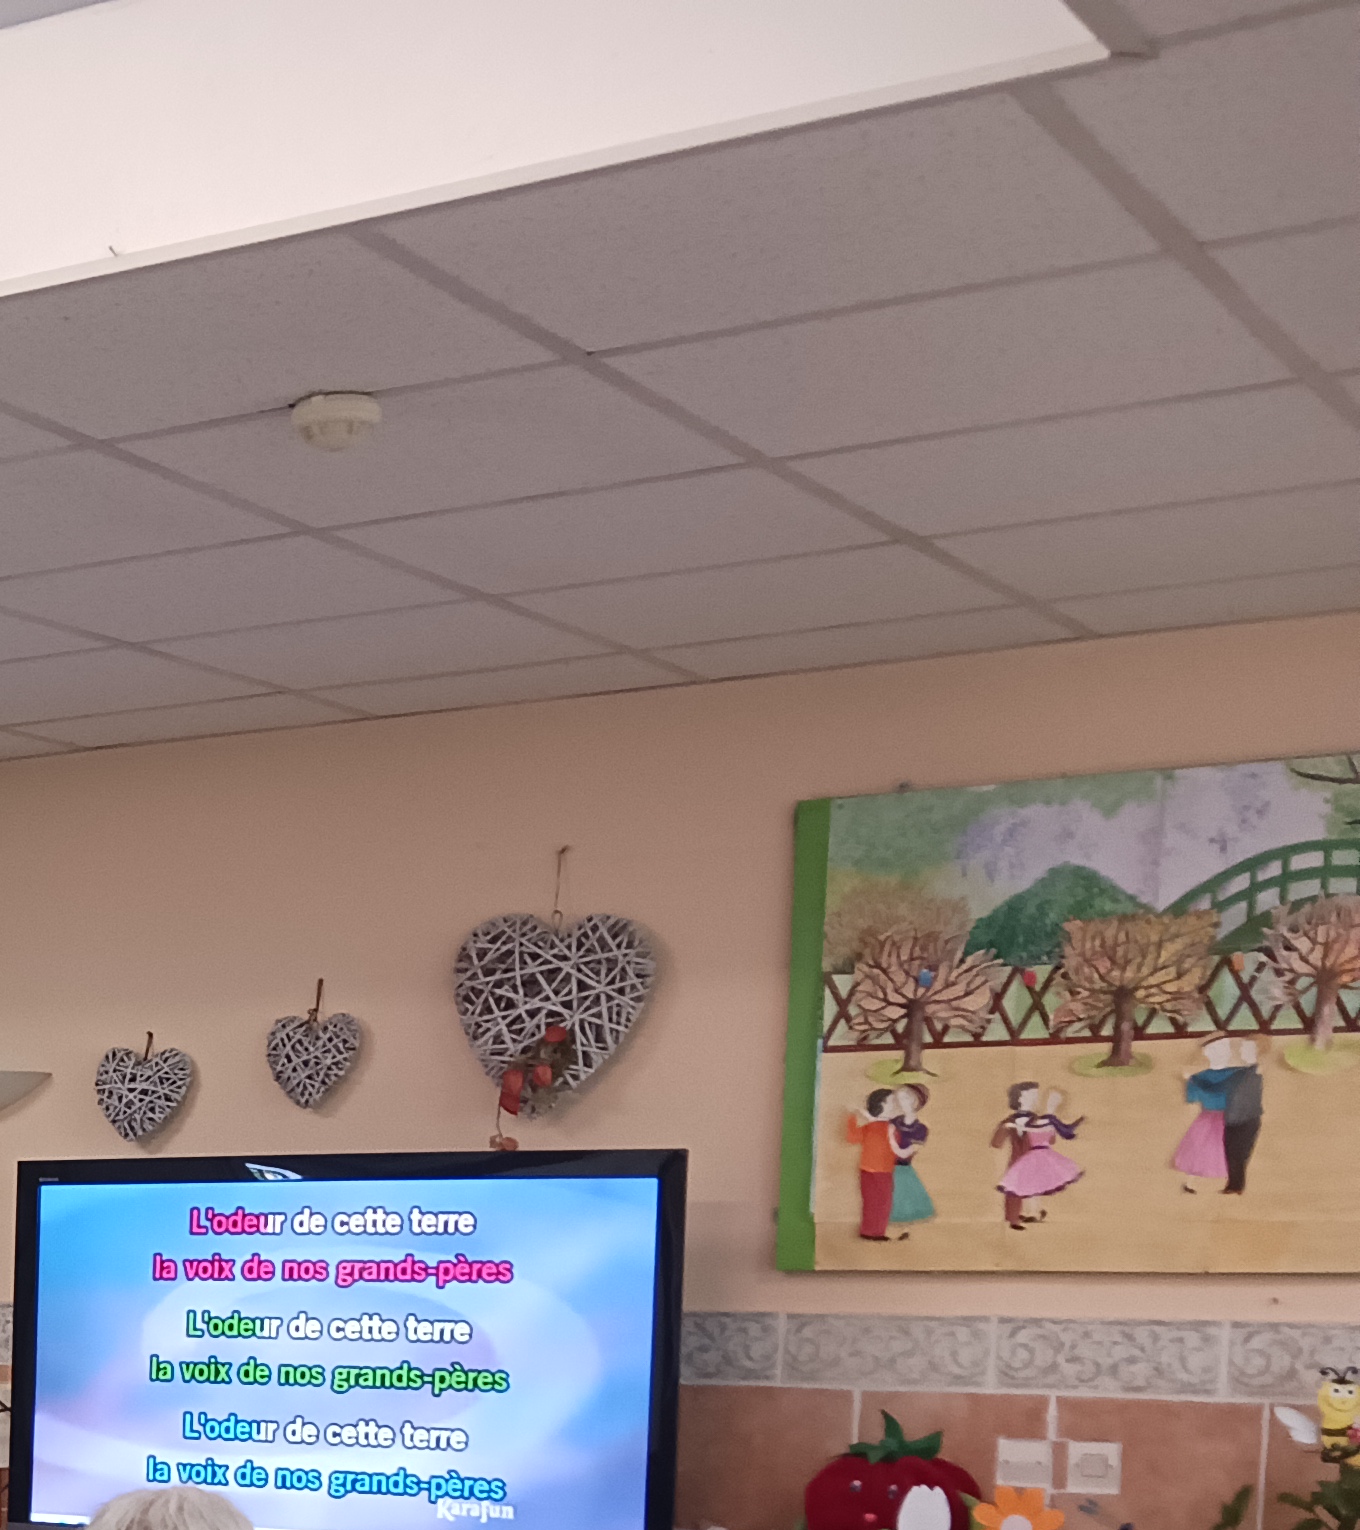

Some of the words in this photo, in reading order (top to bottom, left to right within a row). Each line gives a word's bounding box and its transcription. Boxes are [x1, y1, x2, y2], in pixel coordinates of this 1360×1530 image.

[189, 1206, 287, 1235] L'odeur
[291, 1206, 327, 1235] de
[332, 1206, 404, 1236] cette
[409, 1205, 477, 1236] terre
[153, 1253, 178, 1281] la
[183, 1253, 235, 1281] voix
[241, 1253, 275, 1281] de
[281, 1259, 329, 1282] nos
[335, 1253, 514, 1289] grands-pères
[186, 1309, 283, 1339] L'odeur
[287, 1311, 323, 1340] de
[328, 1312, 400, 1342] cette
[404, 1313, 473, 1344] terre
[149, 1354, 174, 1382] la
[179, 1355, 232, 1384] voix
[237, 1356, 272, 1386] de
[278, 1364, 326, 1387] nos
[330, 1360, 510, 1397] grands-pères
[183, 1411, 279, 1442] L'odeur
[283, 1415, 320, 1445] de
[324, 1418, 396, 1448] cette
[400, 1420, 469, 1452] terre
[146, 1455, 171, 1483] la
[176, 1457, 229, 1486] voix
[234, 1459, 269, 1488] de
[274, 1467, 322, 1491] nos
[328, 1466, 507, 1504] grands-pères
